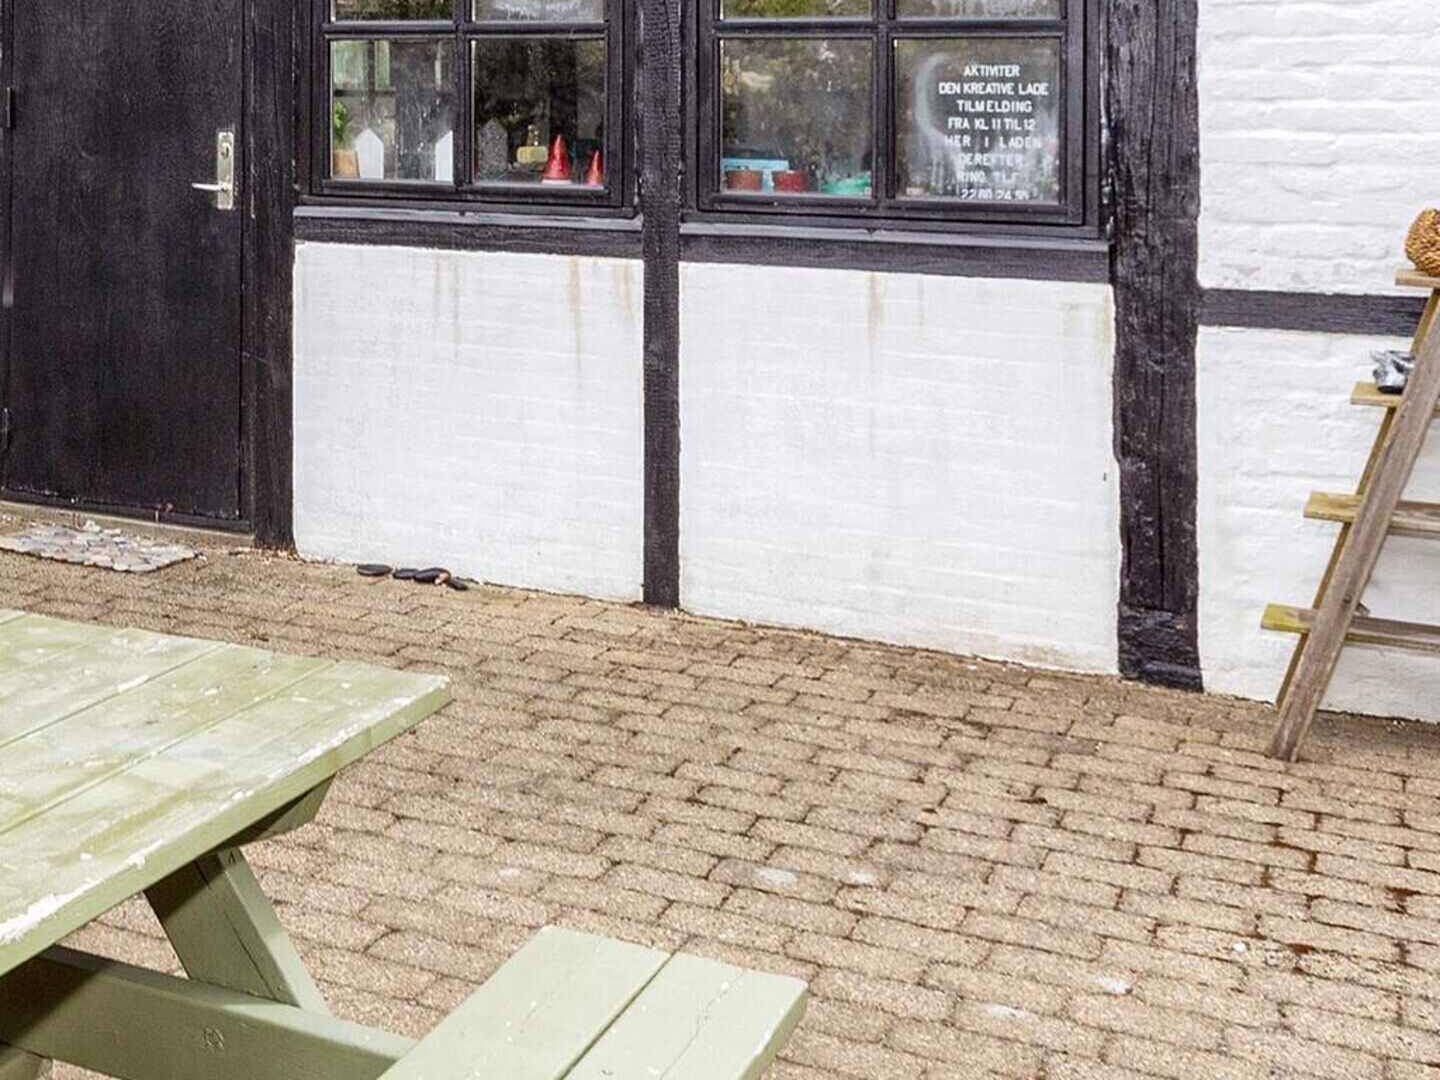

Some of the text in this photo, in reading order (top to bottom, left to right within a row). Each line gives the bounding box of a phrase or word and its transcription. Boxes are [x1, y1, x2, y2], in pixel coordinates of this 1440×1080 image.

[939, 83, 1049, 96] DEN KREATIVE LADE
[956, 100, 1033, 113] TILMELDING
[948, 117, 970, 130] FRA
[974, 118, 989, 130] KL
[1004, 118, 1022, 131] TIL
[1024, 119, 1036, 131] 12
[944, 135, 971, 148] HER
[1000, 136, 1042, 149] LADEN
